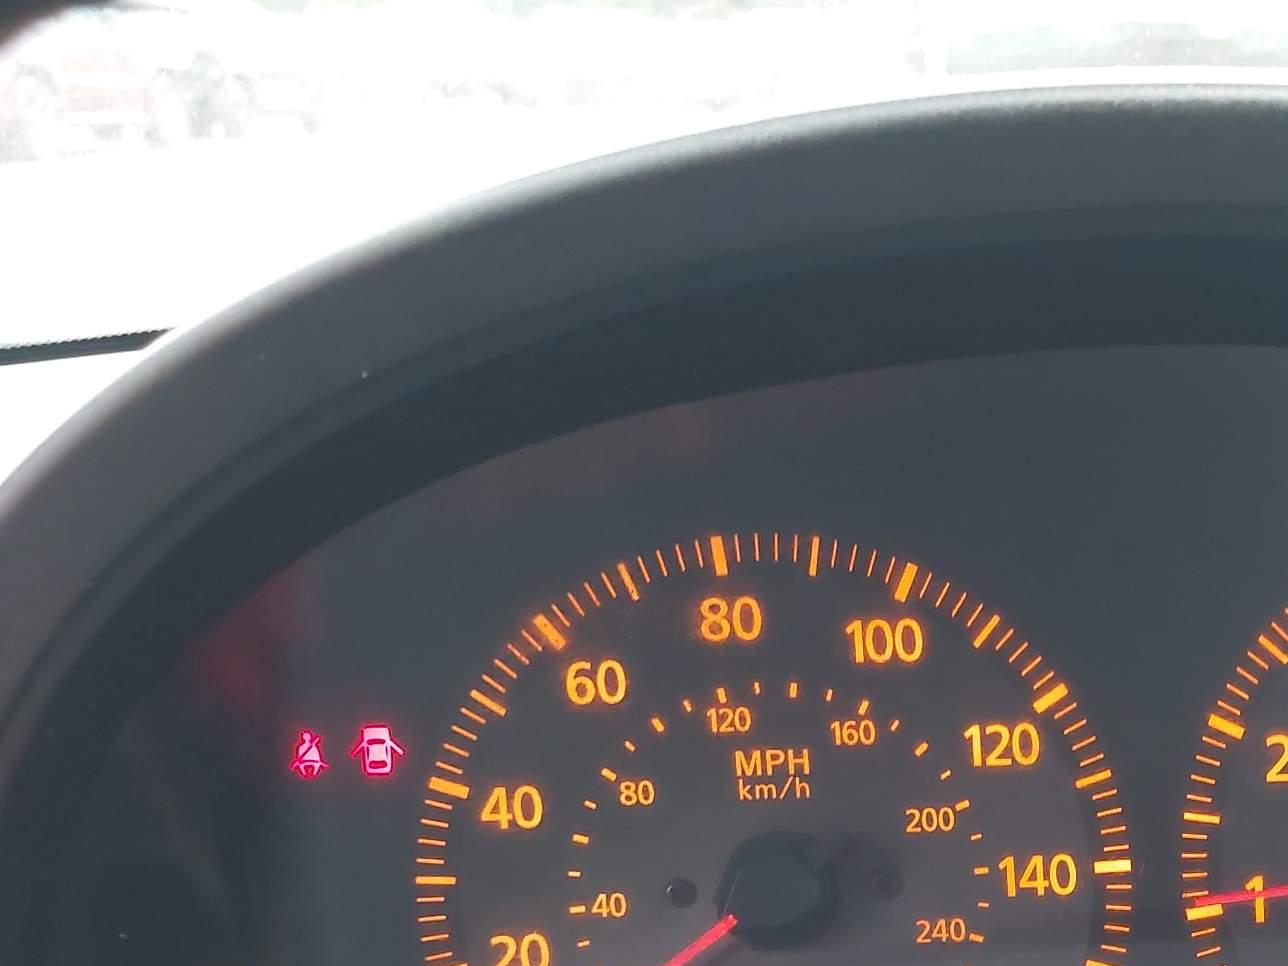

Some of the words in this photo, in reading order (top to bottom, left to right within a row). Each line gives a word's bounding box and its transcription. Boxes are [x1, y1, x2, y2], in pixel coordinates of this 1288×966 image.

[699, 596, 763, 642] 80
[845, 617, 924, 665] 100
[564, 659, 627, 705] 60
[706, 704, 753, 735] 120
[830, 718, 877, 747] 160
[964, 720, 1041, 769] 120
[734, 749, 811, 778] MPH
[618, 779, 655, 806] 80
[737, 777, 812, 801] km/h
[480, 784, 543, 830] 40
[905, 806, 955, 834] 200
[998, 852, 1078, 897] 140
[591, 892, 627, 917] 40
[1247, 874, 1268, 923] 1
[915, 917, 966, 945] 240
